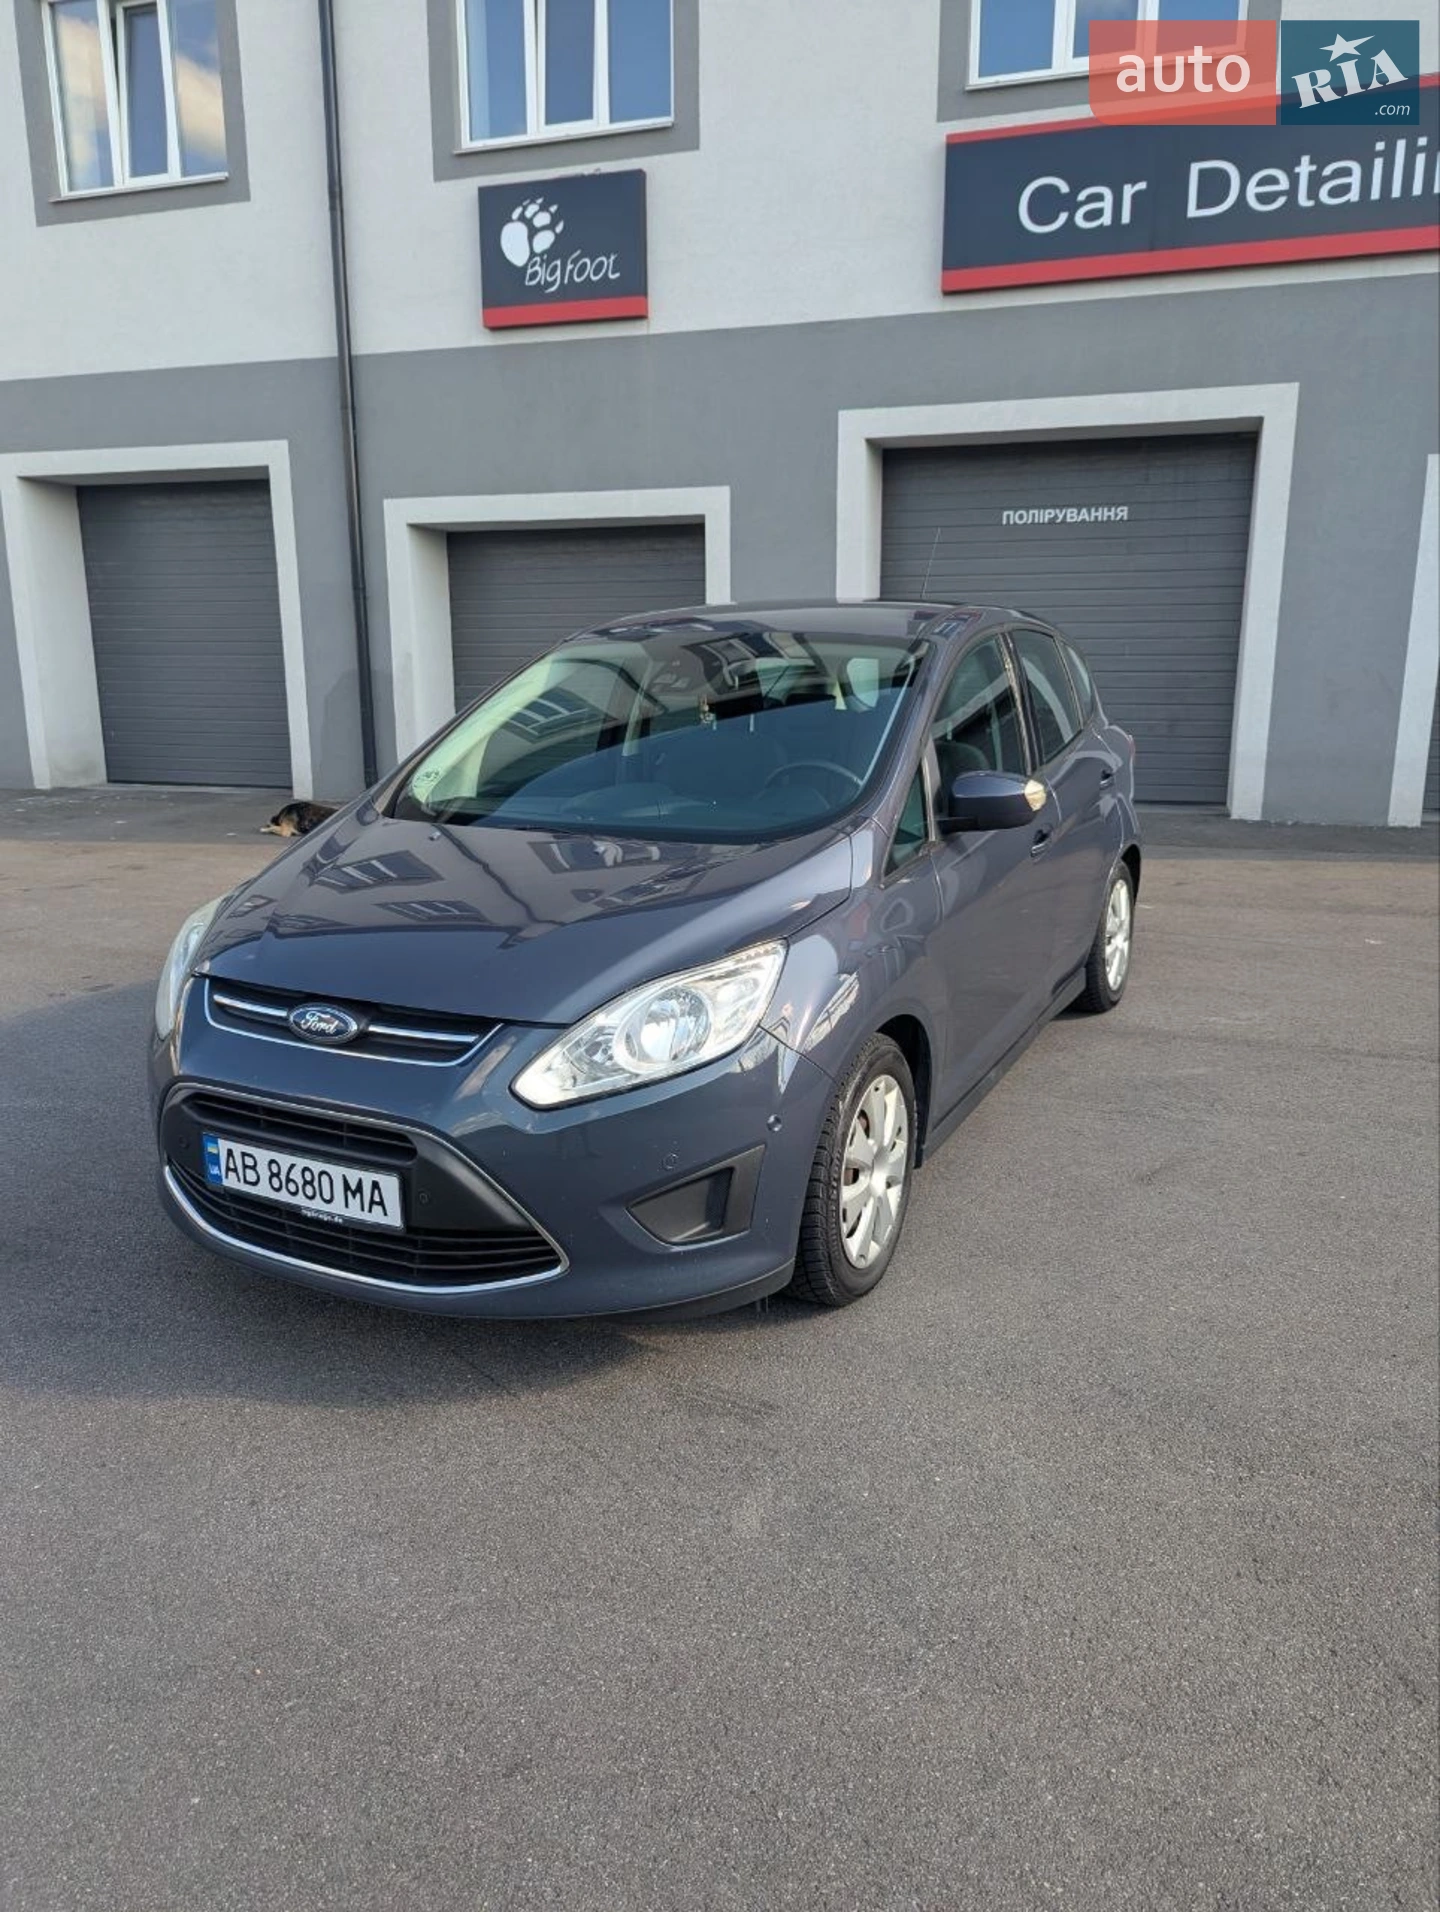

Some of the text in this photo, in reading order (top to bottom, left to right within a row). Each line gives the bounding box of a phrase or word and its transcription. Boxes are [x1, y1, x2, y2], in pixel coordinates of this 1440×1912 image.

[1018, 136, 1440, 234] Car Detaili
[1002, 506, 1129, 525] ПОЛІРУВАННЯ
[301, 1011, 339, 1034] Ford
[225, 1147, 388, 1217] AB 8680 MA
